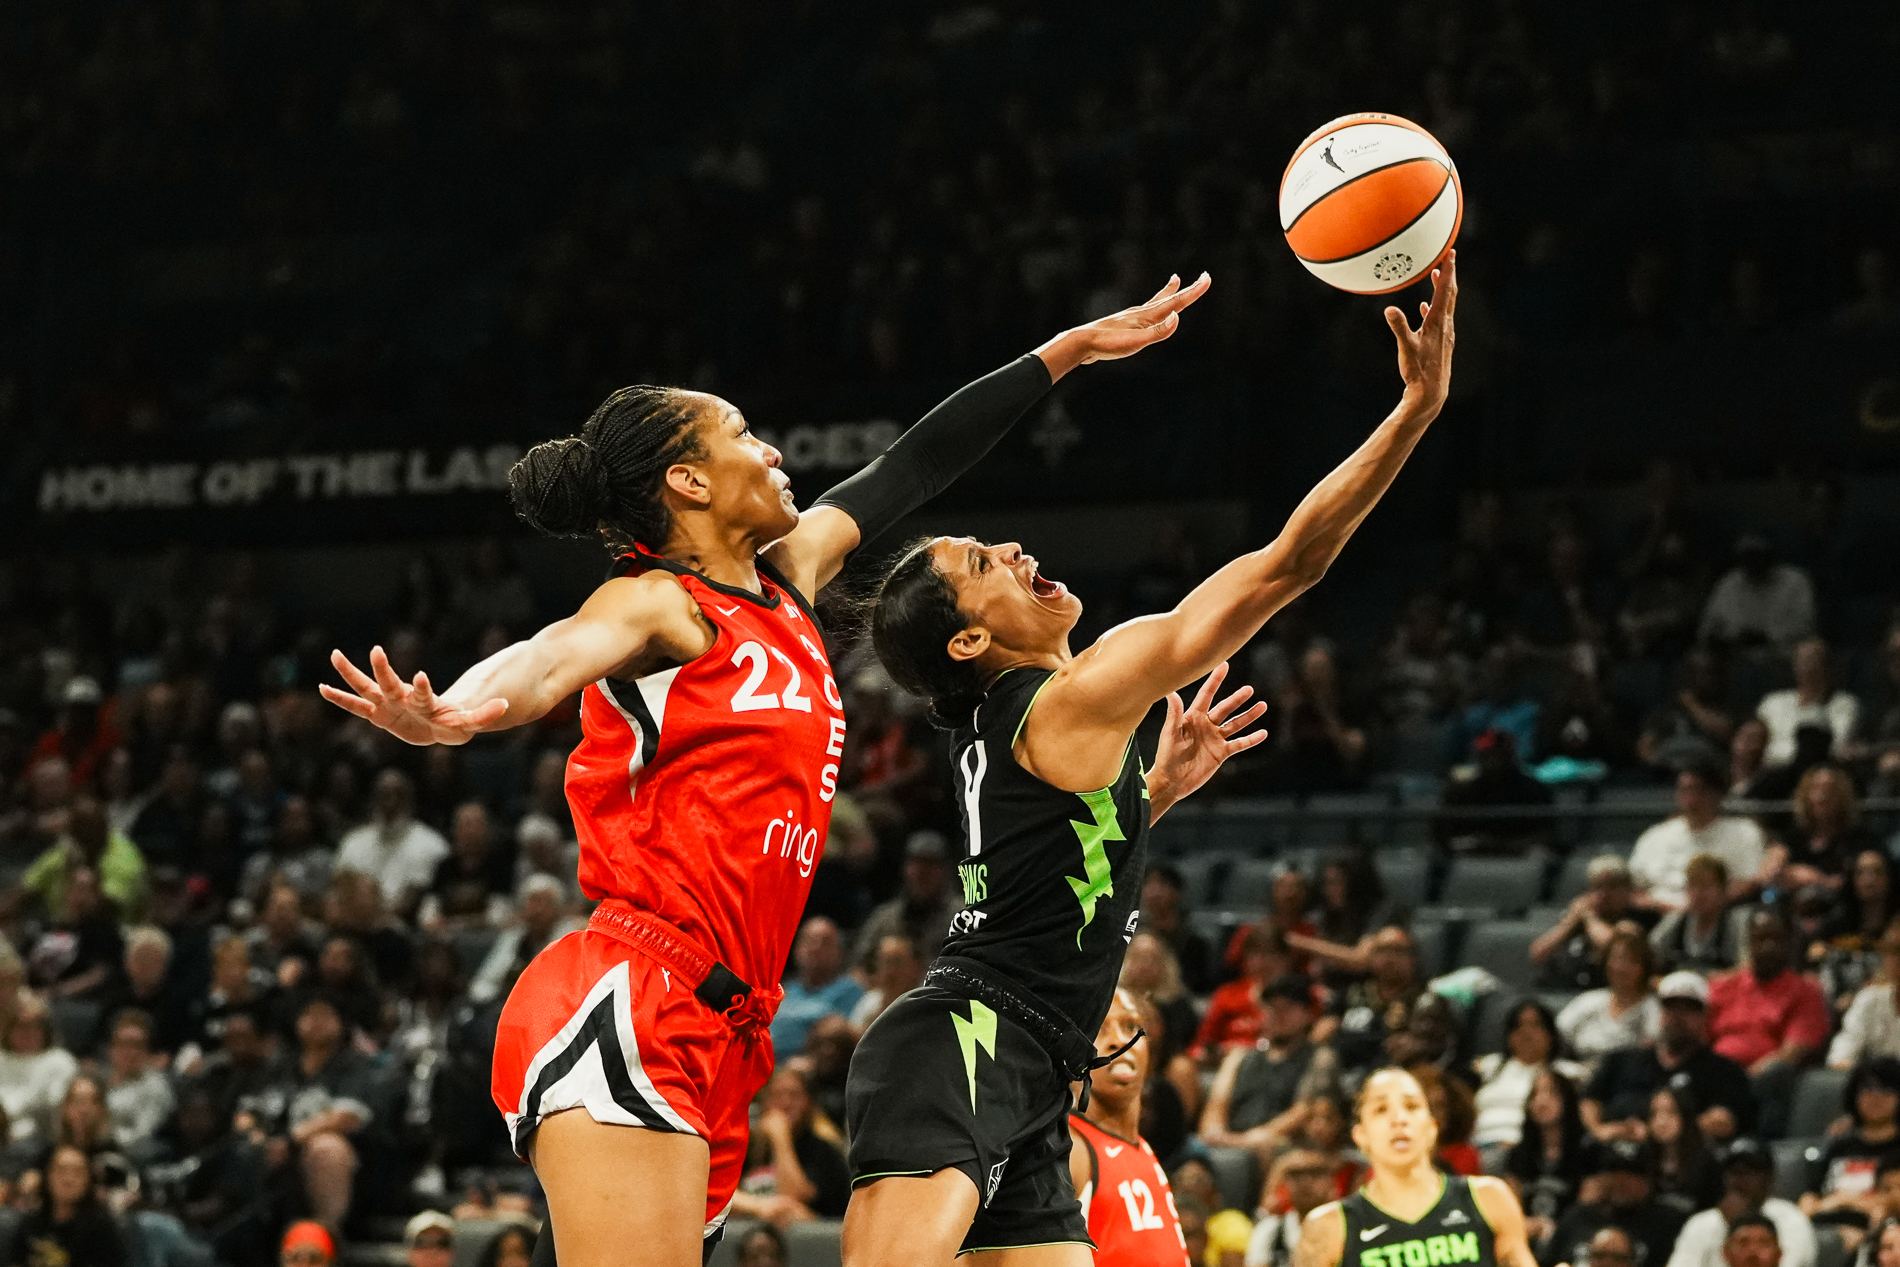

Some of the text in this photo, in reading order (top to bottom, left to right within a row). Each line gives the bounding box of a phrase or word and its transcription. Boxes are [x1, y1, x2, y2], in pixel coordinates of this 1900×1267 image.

[40, 463, 197, 509] HOME
[203, 459, 279, 503] OF
[288, 450, 402, 498] THE
[730, 640, 812, 713] 22
[799, 634, 847, 802] ACES
[762, 809, 818, 878] ring
[1118, 1178, 1164, 1231] 12
[1360, 1230, 1480, 1267] STORM
